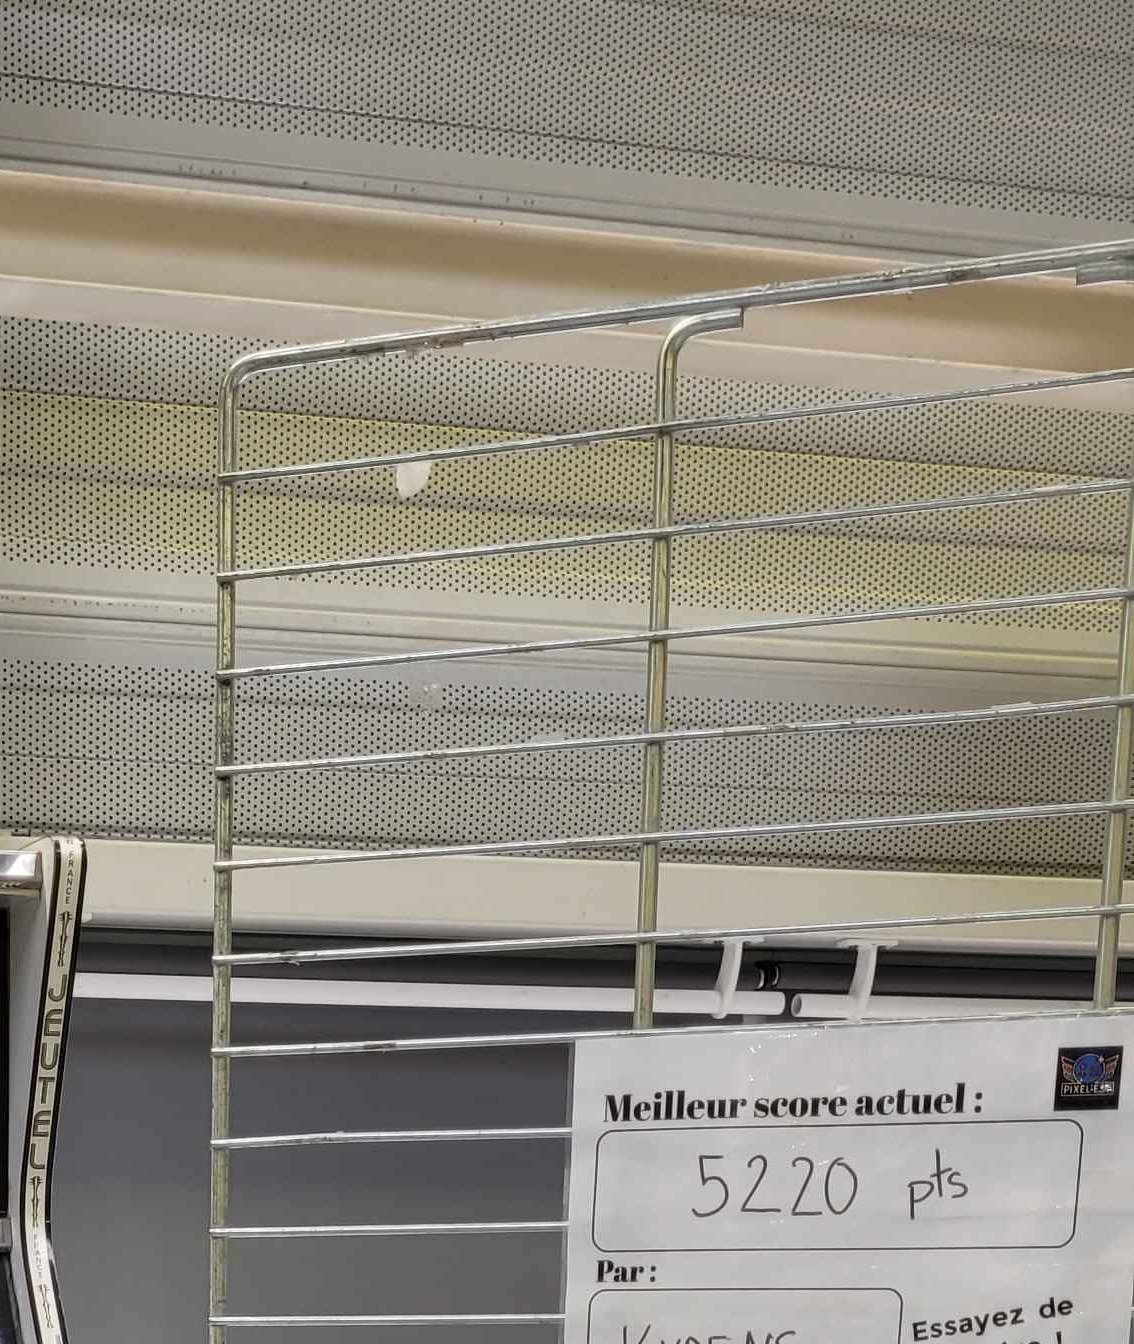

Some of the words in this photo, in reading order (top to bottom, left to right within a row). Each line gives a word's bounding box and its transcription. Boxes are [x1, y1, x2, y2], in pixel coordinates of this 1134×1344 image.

[65, 850, 74, 905] FRANCE
[29, 976, 67, 1170] JEUTEL
[603, 1091, 747, 1123] Meilleur
[753, 1096, 847, 1119] score
[855, 1083, 965, 1116] actuel
[692, 1154, 859, 1218] 5220
[908, 1148, 969, 1220] pts
[912, 1304, 1025, 1344] Essayez
[1039, 1296, 1075, 1320] de
